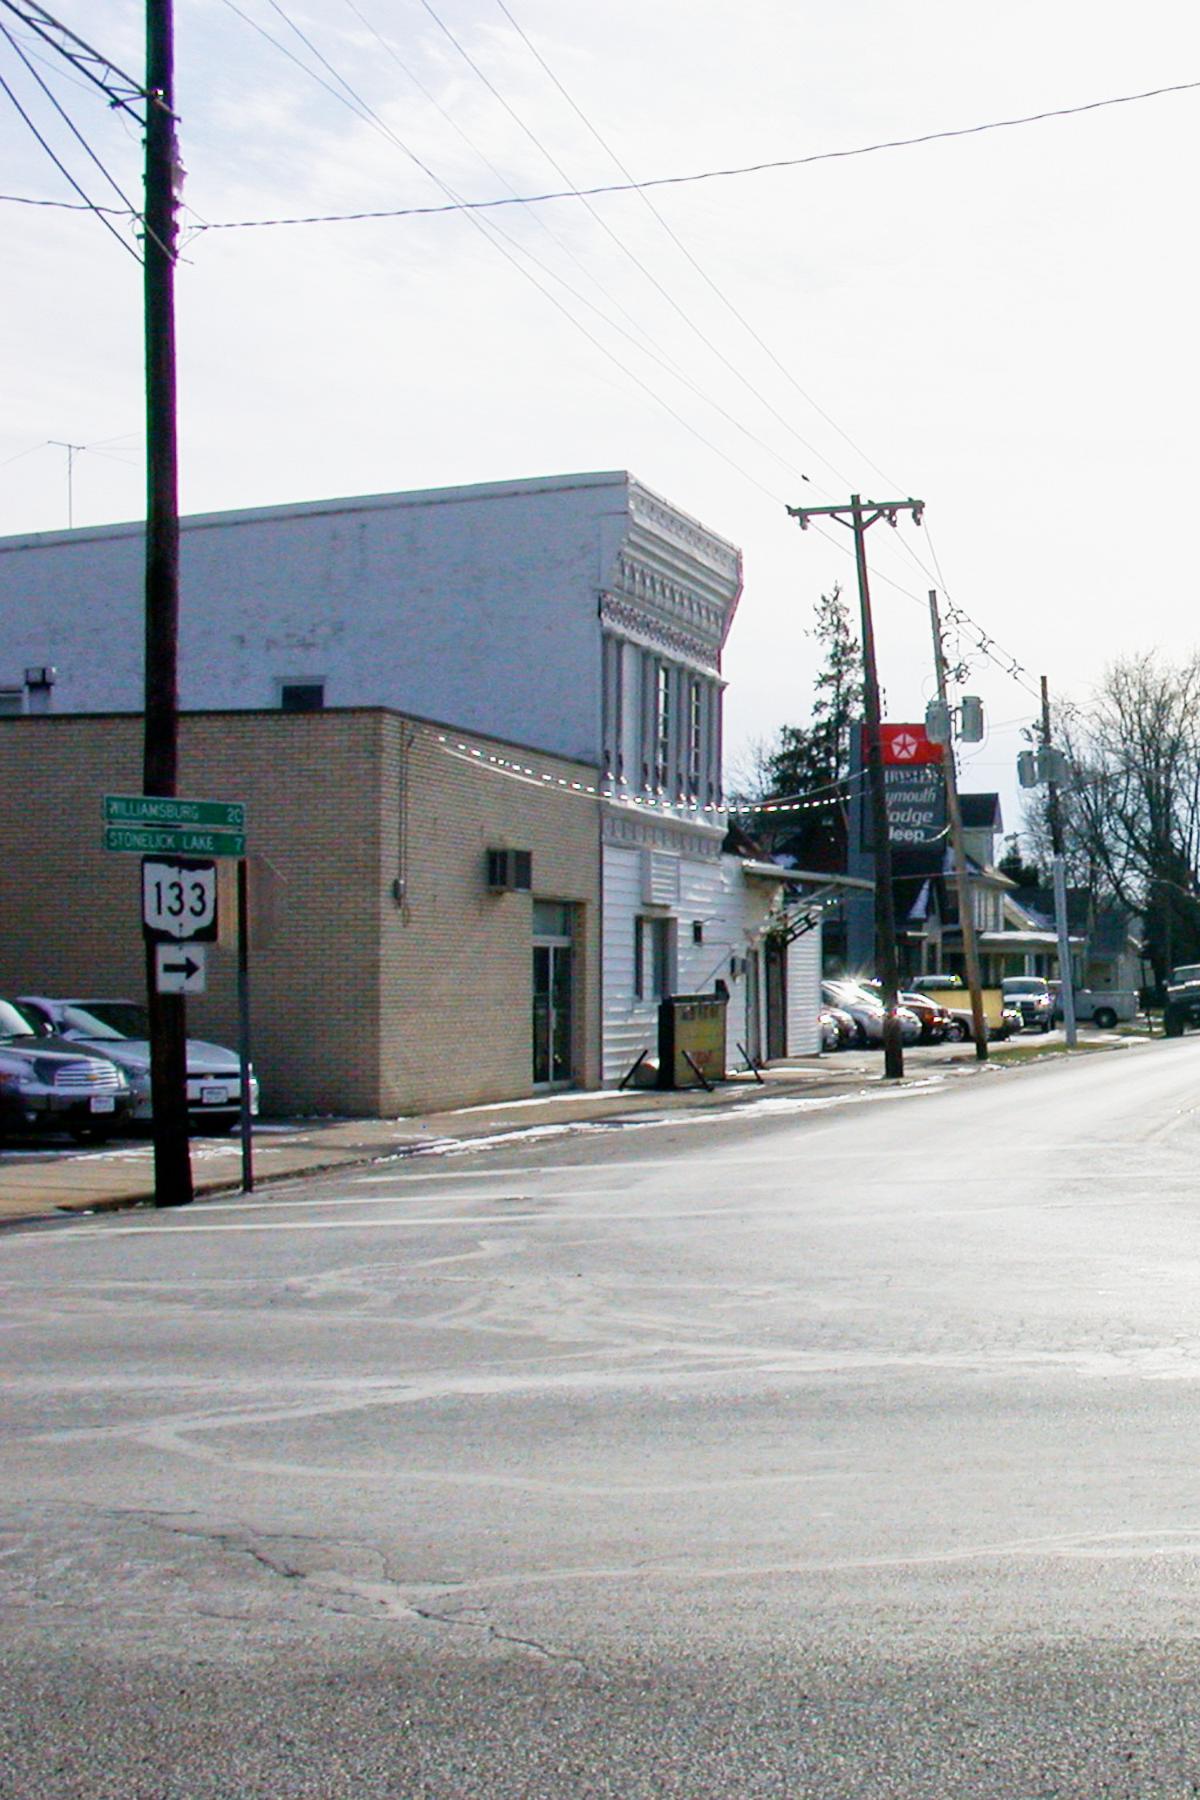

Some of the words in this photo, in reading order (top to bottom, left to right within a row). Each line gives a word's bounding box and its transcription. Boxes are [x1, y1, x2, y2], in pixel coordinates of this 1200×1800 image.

[109, 801, 200, 820] WILLIAMSBURG
[109, 831, 175, 849] STONELICK
[183, 836, 215, 851] LAKE
[234, 838, 243, 851] 7
[154, 881, 207, 917] 133
